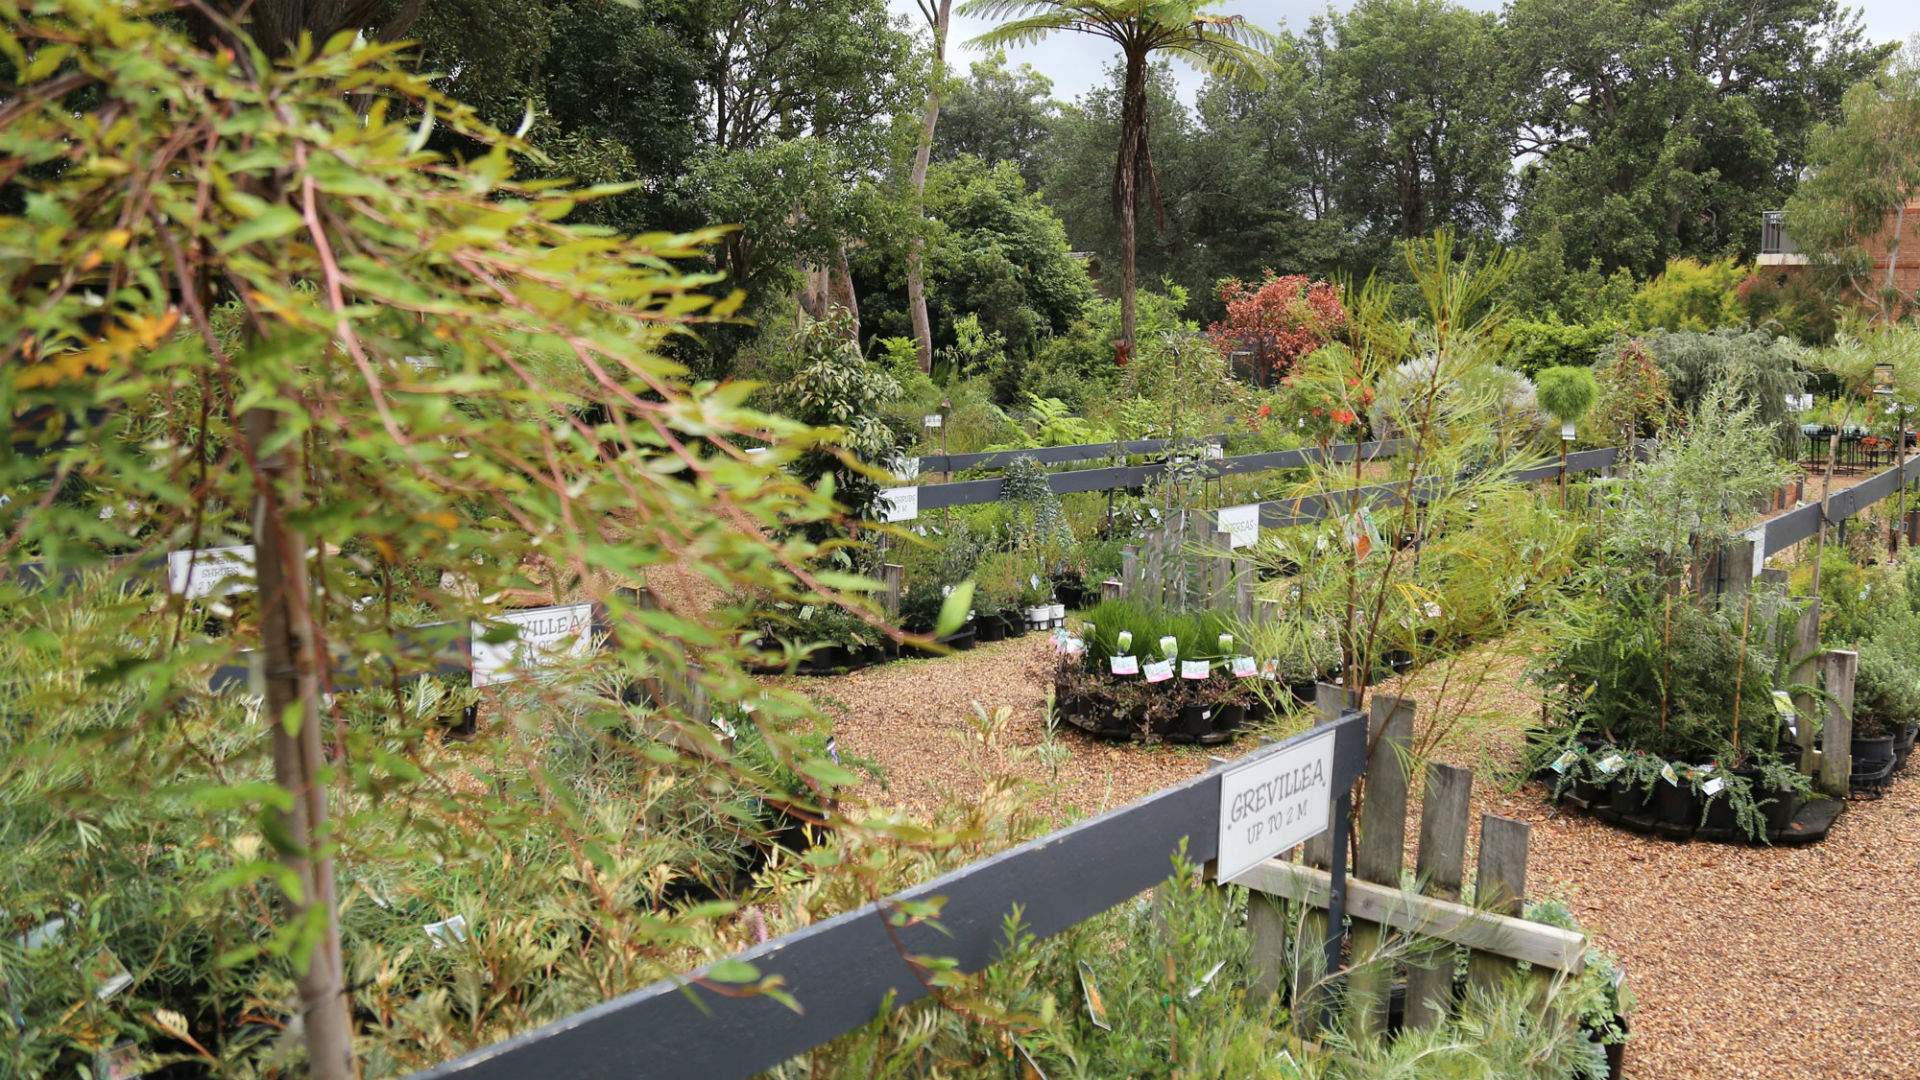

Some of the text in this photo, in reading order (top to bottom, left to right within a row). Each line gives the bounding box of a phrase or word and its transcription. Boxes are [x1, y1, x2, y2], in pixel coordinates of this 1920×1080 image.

[511, 614, 582, 640] VILLEA
[1230, 758, 1325, 822] GREVILLEA
[1247, 800, 1309, 845] UP TO 2 M
